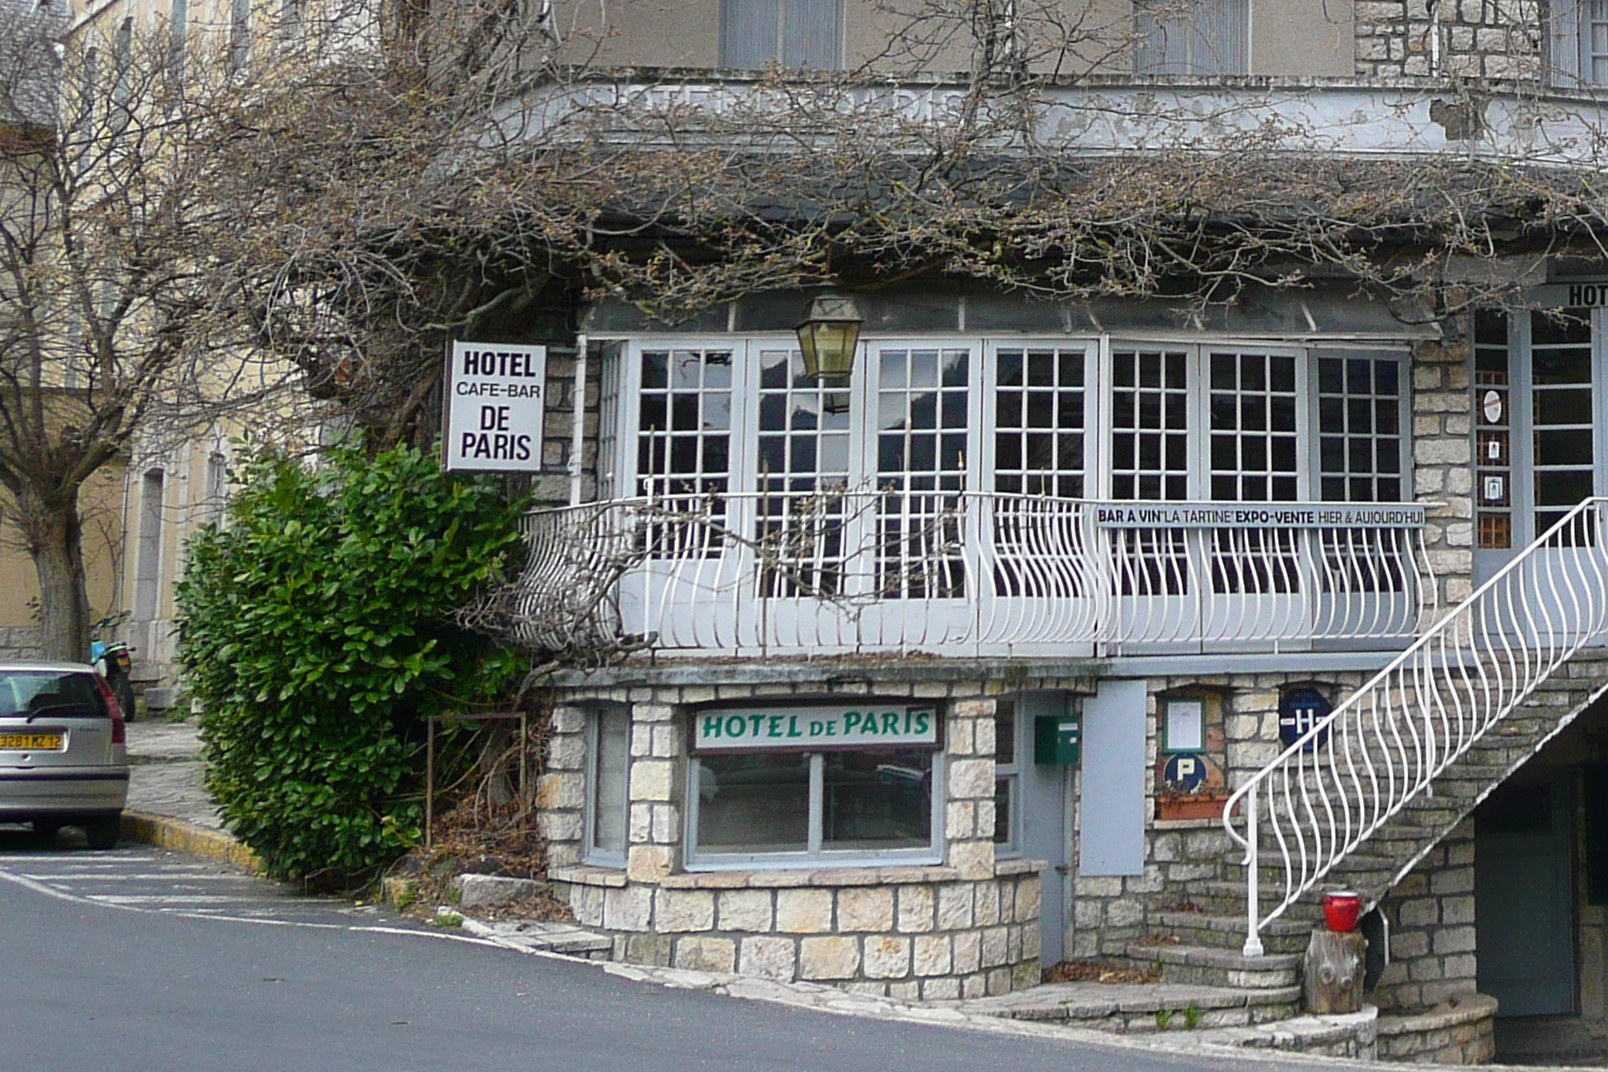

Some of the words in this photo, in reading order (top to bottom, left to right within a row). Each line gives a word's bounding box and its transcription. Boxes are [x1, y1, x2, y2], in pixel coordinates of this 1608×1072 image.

[463, 350, 536, 377] HOTEL
[456, 381, 541, 399] CAFE-BAR
[479, 405, 510, 432] DE
[460, 432, 531, 461] PARIS
[1097, 509, 1124, 523] BAR
[1127, 509, 1137, 523] A
[1235, 509, 1314, 524] EXPO-VENTE
[1318, 510, 1342, 524] HIER
[1344, 512, 1352, 524] &
[1355, 510, 1423, 526] AUJOURD'HUI
[702, 715, 804, 738] HOTEL
[808, 720, 837, 737] DE
[843, 711, 930, 735] PARIS
[1177, 758, 1195, 781] P
